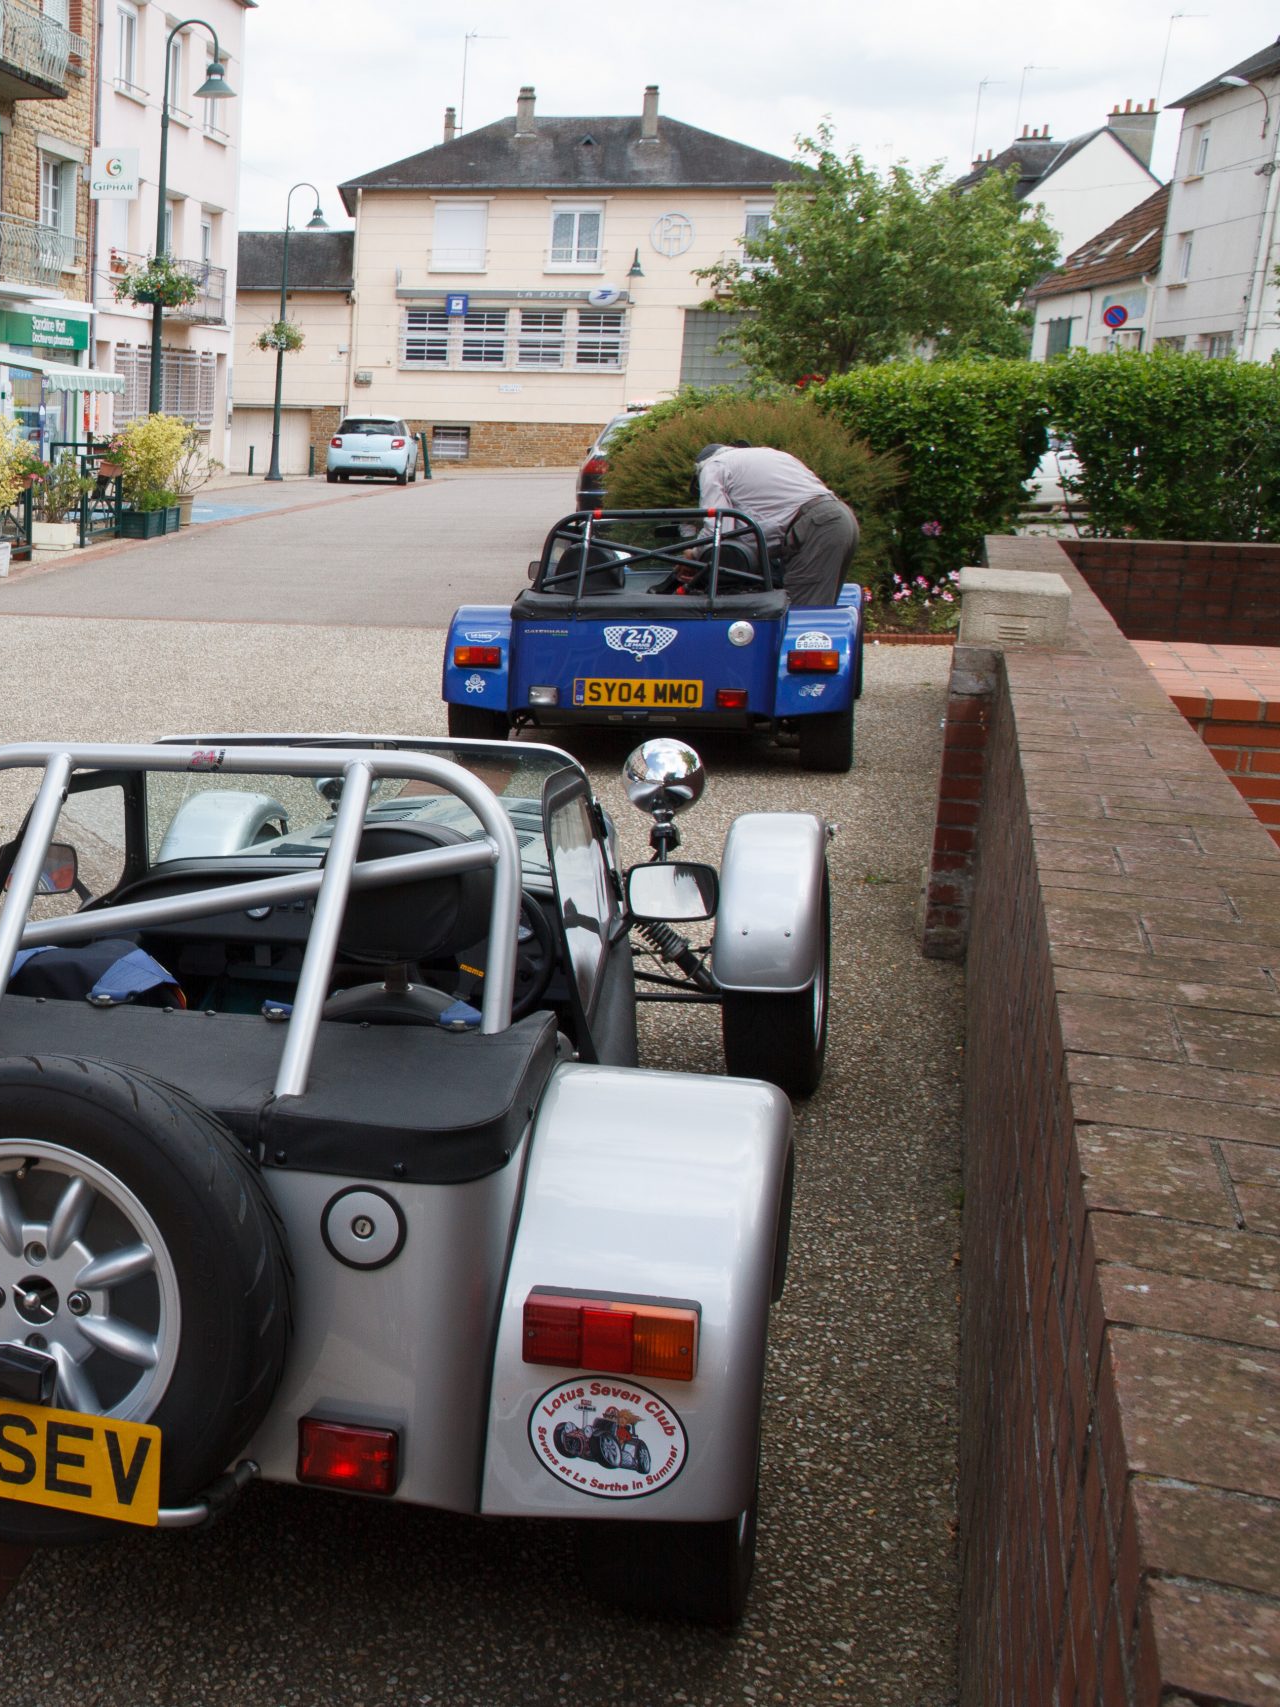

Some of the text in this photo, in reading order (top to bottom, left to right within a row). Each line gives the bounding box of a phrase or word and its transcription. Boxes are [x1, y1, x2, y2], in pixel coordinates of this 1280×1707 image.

[588, 682, 698, 704] SY04 MMO
[542, 1386, 585, 1418] Lotus
[589, 1382, 642, 1404] Seven
[644, 1400, 676, 1437] Club
[537, 1425, 560, 1466] Sevens
[559, 1465, 573, 1476] at
[573, 1471, 587, 1484] La
[589, 1478, 629, 1492] Sarthe
[645, 1444, 680, 1485] Summer
